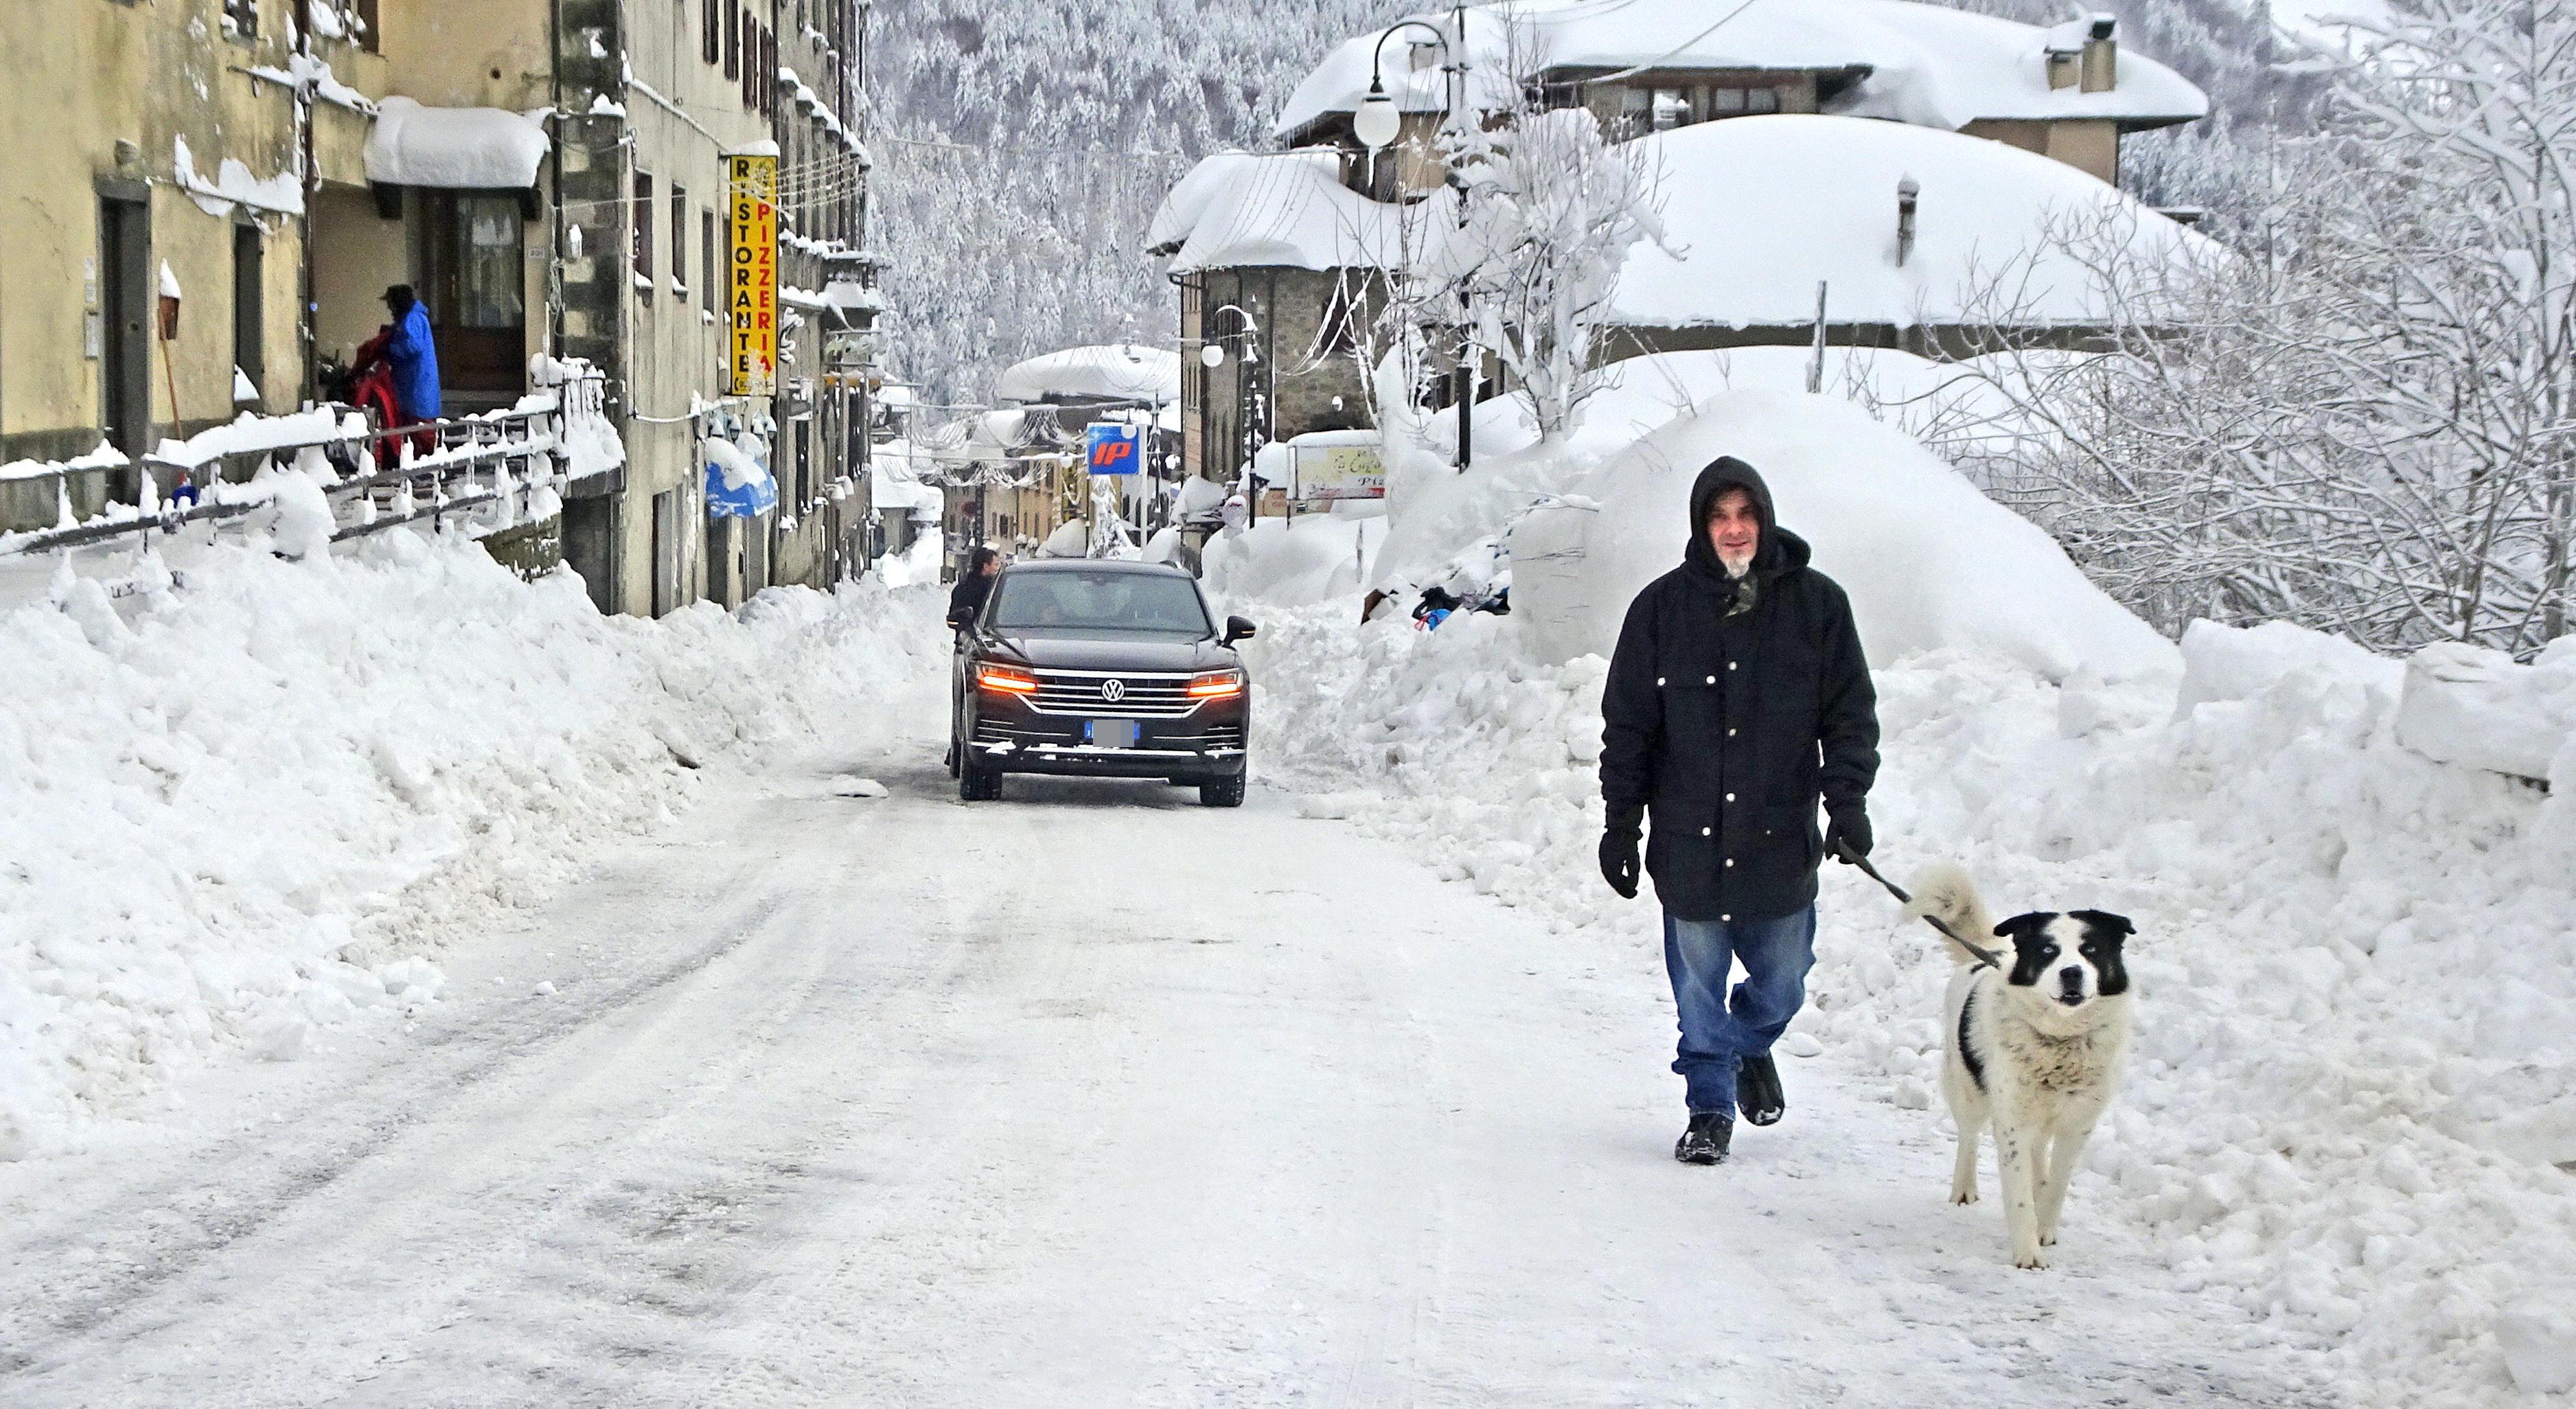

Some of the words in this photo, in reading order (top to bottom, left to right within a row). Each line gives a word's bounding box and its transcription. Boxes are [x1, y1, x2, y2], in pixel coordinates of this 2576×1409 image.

[757, 203, 772, 372] PIZZERIA
[1092, 442, 1132, 465] IP
[1102, 679, 1125, 702] VW
